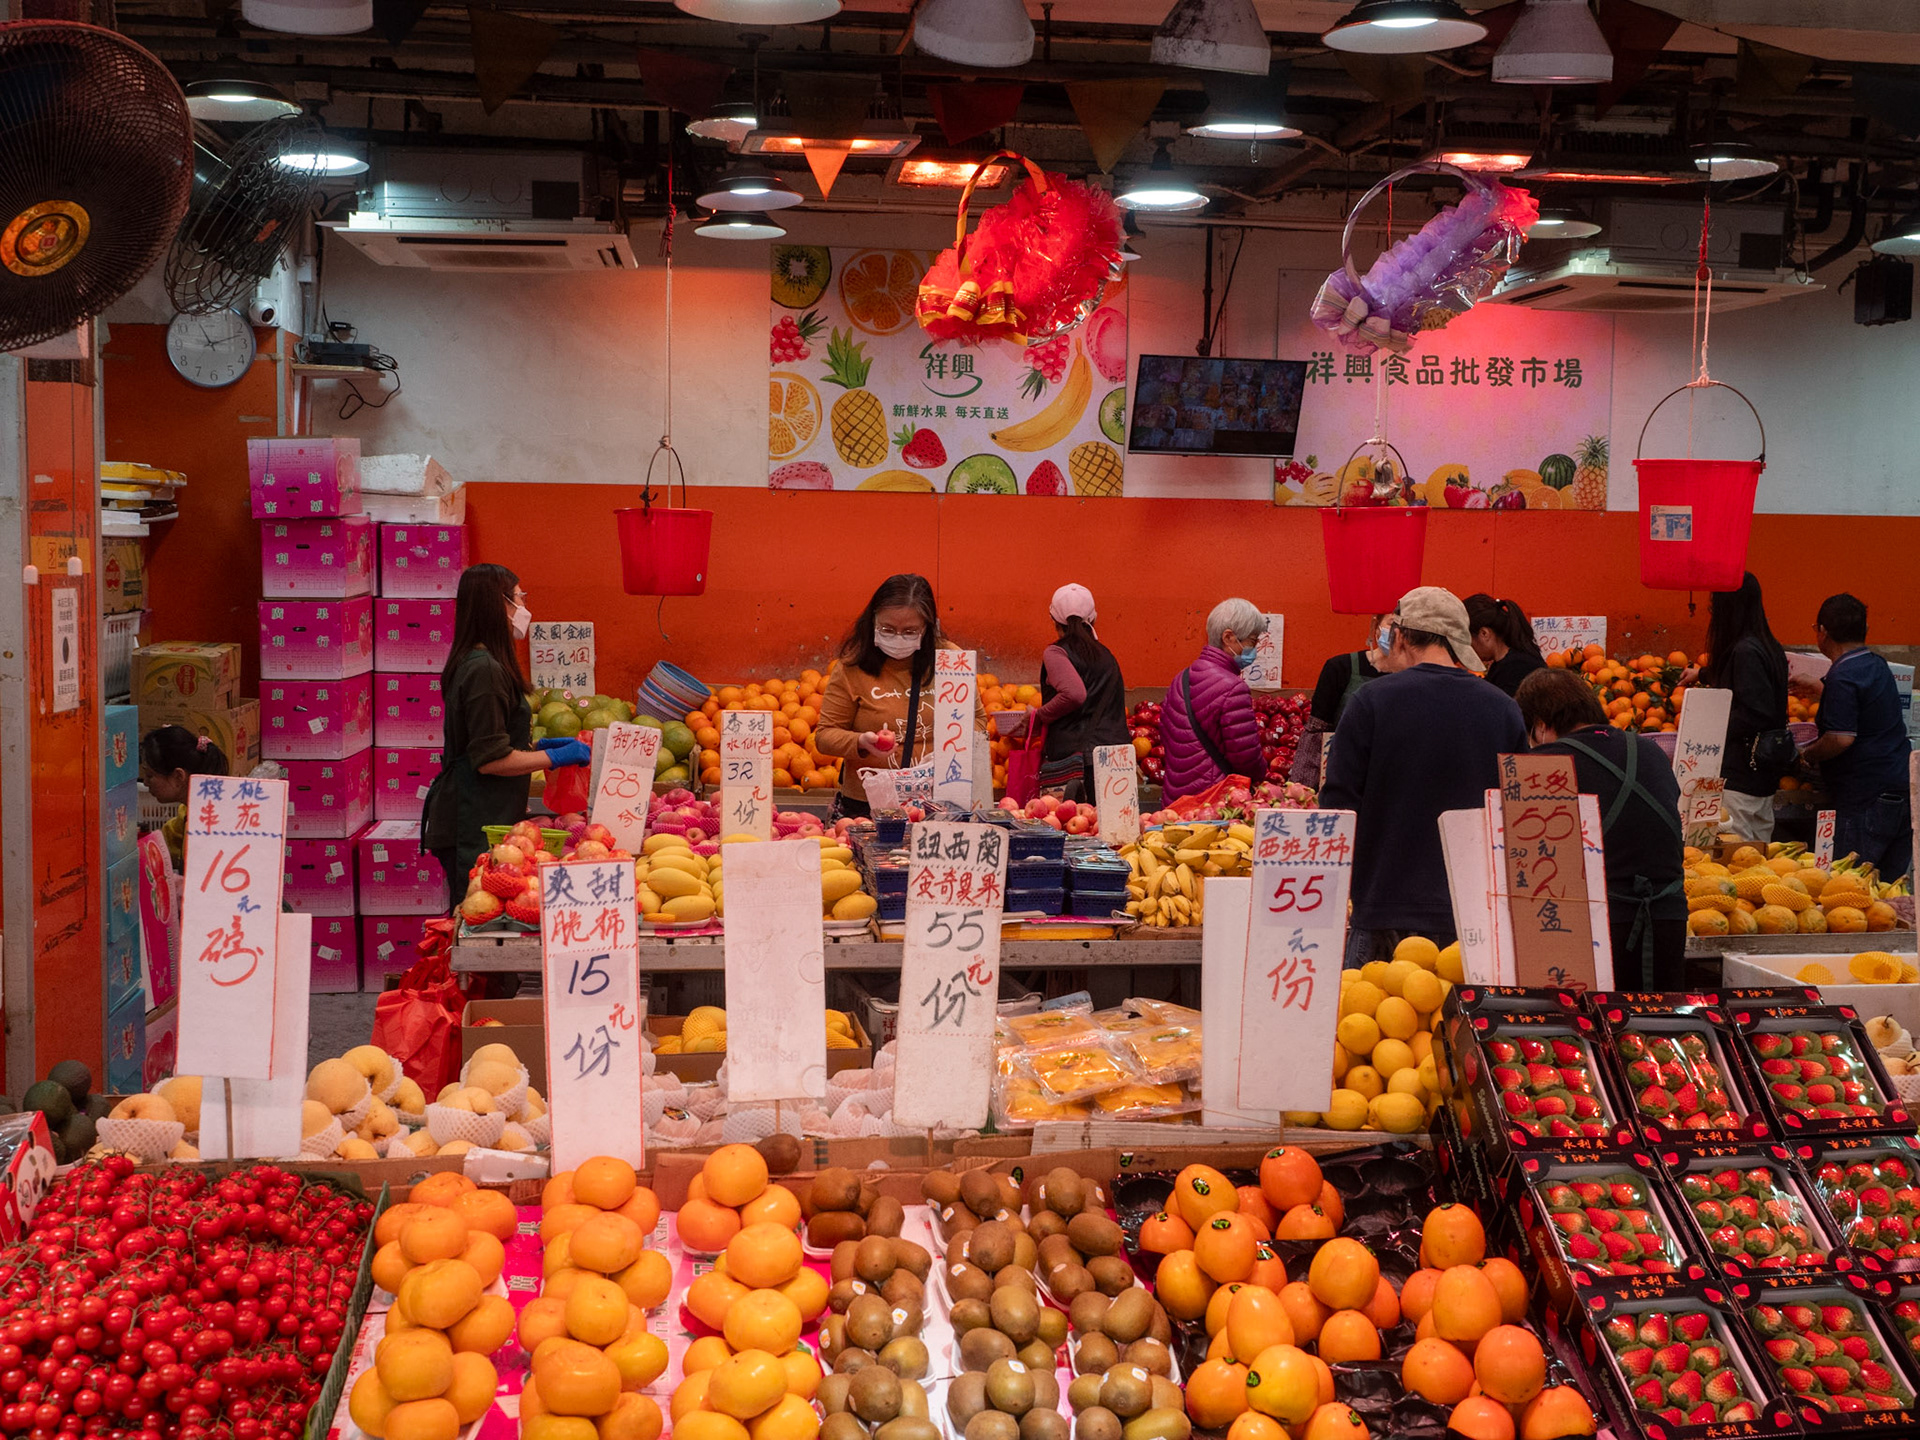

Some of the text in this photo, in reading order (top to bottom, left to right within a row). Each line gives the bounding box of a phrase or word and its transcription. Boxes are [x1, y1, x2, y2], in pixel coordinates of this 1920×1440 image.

[180, 355, 188, 366] 8
[195, 366, 202, 377] 7
[227, 365, 235, 376] 5
[237, 354, 245, 365] 4
[925, 351, 976, 381] 祥興
[1305, 350, 1584, 389] 祥興食品批發市場
[210, 370, 218, 381] 6
[892, 403, 1010, 420] 新鮮水果 每天直送
[1892, 674, 1912, 682] PLES
[939, 681, 969, 704] 20
[943, 722, 968, 752] 2
[601, 768, 640, 798] 28
[727, 761, 754, 781] 32
[197, 778, 270, 801] 櫻桃
[752, 786, 768, 801] 元
[1104, 776, 1129, 799] 10
[199, 801, 261, 834] 串茄
[733, 799, 760, 826] 份
[1695, 798, 1720, 819] 25
[1261, 812, 1340, 837] 爽甜
[1512, 805, 1575, 841] 55
[1817, 822, 1833, 838] 18
[917, 827, 1001, 867] 紐西蘭
[1258, 833, 1350, 862] 西班牙柿
[1509, 848, 1528, 859] 30
[1538, 839, 1556, 857] 元
[200, 844, 251, 893] 16
[1515, 859, 1528, 869] 元
[545, 864, 624, 904] 爽甜
[910, 866, 1000, 904] 金奇異果
[1269, 874, 1325, 913] 55
[1530, 857, 1559, 902] 2
[237, 895, 261, 913] 元
[1537, 899, 1572, 932] 盒
[551, 907, 625, 948] 脆柿
[926, 910, 984, 951] 55
[1288, 928, 1319, 953] 元
[199, 915, 265, 987] 磅
[568, 953, 610, 996] 15
[968, 953, 993, 986] 元
[1267, 956, 1317, 1011] 份
[921, 970, 981, 1030] 份
[609, 1003, 635, 1031] 元
[563, 1025, 621, 1081] 份
